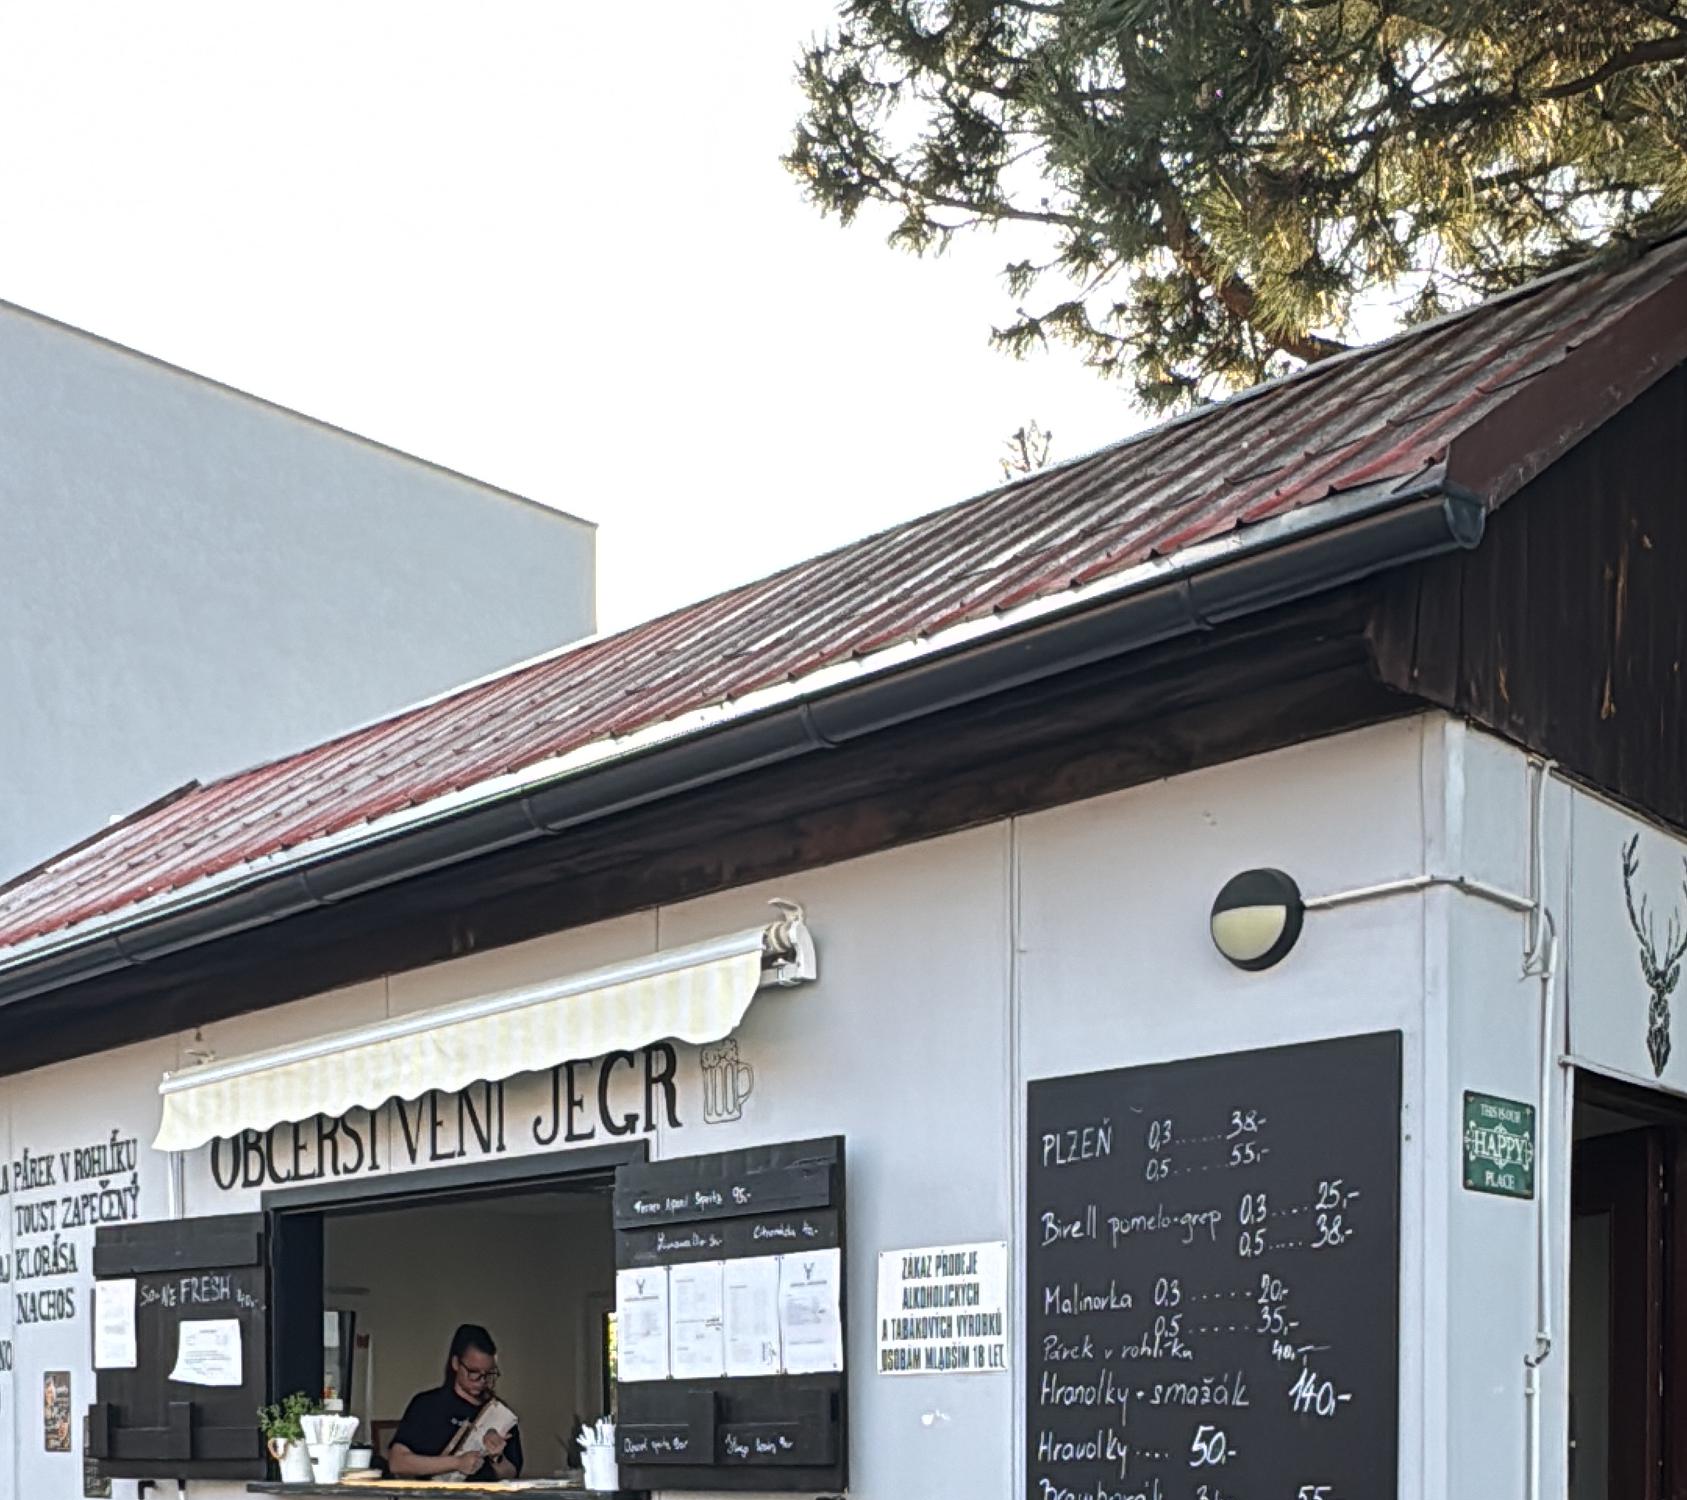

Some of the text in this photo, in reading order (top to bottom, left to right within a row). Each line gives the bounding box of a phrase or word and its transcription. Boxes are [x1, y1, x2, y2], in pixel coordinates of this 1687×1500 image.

[1043, 1118, 1113, 1166] PLZEŇ
[1148, 1120, 1173, 1151] 0,3
[1474, 1129, 1526, 1161] HAPPY
[13, 1148, 55, 1192] PÁREK
[60, 1152, 71, 1183] V
[74, 1129, 138, 1181] ROHLÍKU
[1146, 1158, 1172, 1181] 0,5
[1485, 1170, 1515, 1190] PLACE
[15, 1199, 57, 1237] TOUST
[61, 1171, 140, 1229] ZAPEČENÝ
[1041, 1204, 1097, 1247] Birell
[1240, 1194, 1267, 1225] 0,3
[16, 1233, 78, 1281] KLOBÁSA
[1239, 1230, 1265, 1257] 0,5
[902, 1250, 978, 1280] ZÁKAZ PRODEJE
[16, 1287, 76, 1324] NACHOS
[180, 1273, 231, 1304] FRESH
[902, 1280, 980, 1310] ALKOHOLICKÝCH
[1044, 1280, 1133, 1315] Malinovka
[1154, 1278, 1181, 1306] 0,3
[881, 1307, 1002, 1341] A TABÁKOVÝCH VÝROBKŮ
[881, 1345, 921, 1371] OSOBÁM
[973, 1344, 985, 1368] 18
[988, 1343, 1005, 1368] LET
[1043, 1334, 1094, 1362] Párek
[1104, 1347, 1114, 1360] v
[1040, 1369, 1128, 1426] Hranolky
[1150, 1370, 1250, 1405] smažák
[1038, 1429, 1128, 1479] Hranolky
